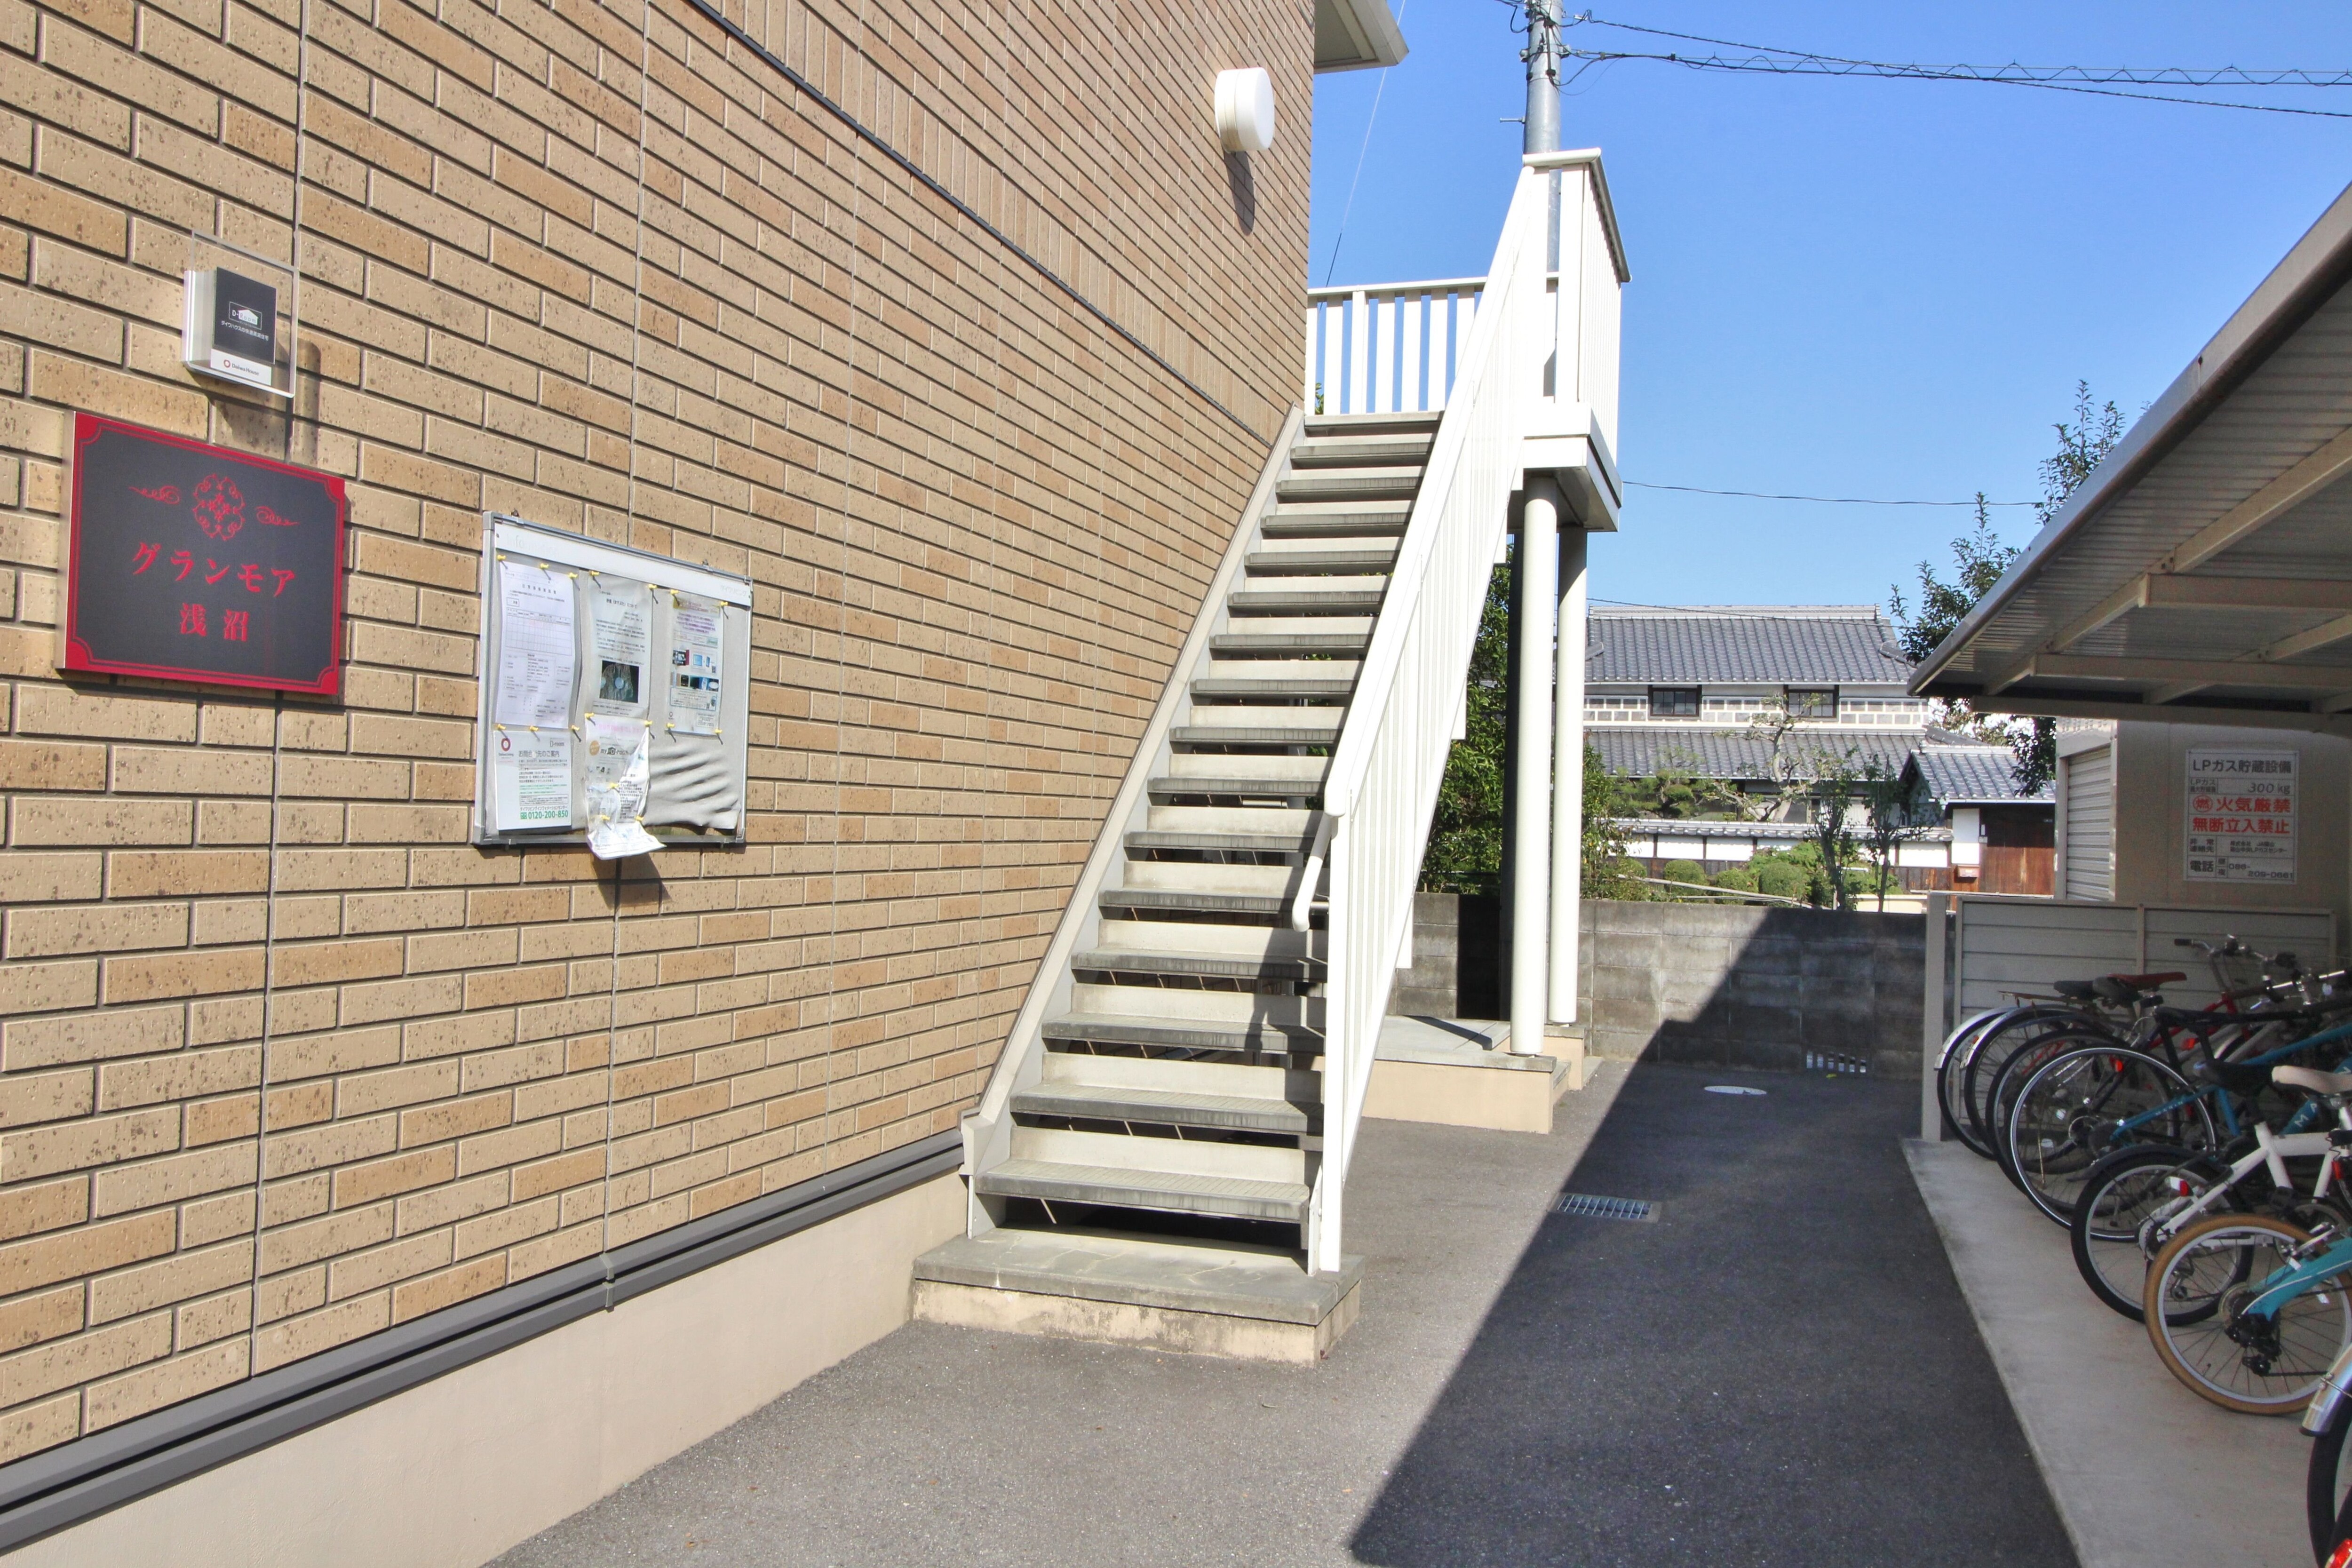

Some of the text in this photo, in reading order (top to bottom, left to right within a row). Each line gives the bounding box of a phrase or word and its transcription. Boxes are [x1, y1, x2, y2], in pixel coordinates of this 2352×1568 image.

[132, 542, 295, 598] グランモア
[179, 603, 250, 642] 浅沼
[2193, 759, 2291, 773] LPガス貯蔵設備
[2248, 783, 2290, 794] 300 kg
[2216, 796, 2291, 813] 火気厳禁
[528, 810, 568, 820] 0120-200-850
[2193, 817, 2290, 834] 無断立入禁止
